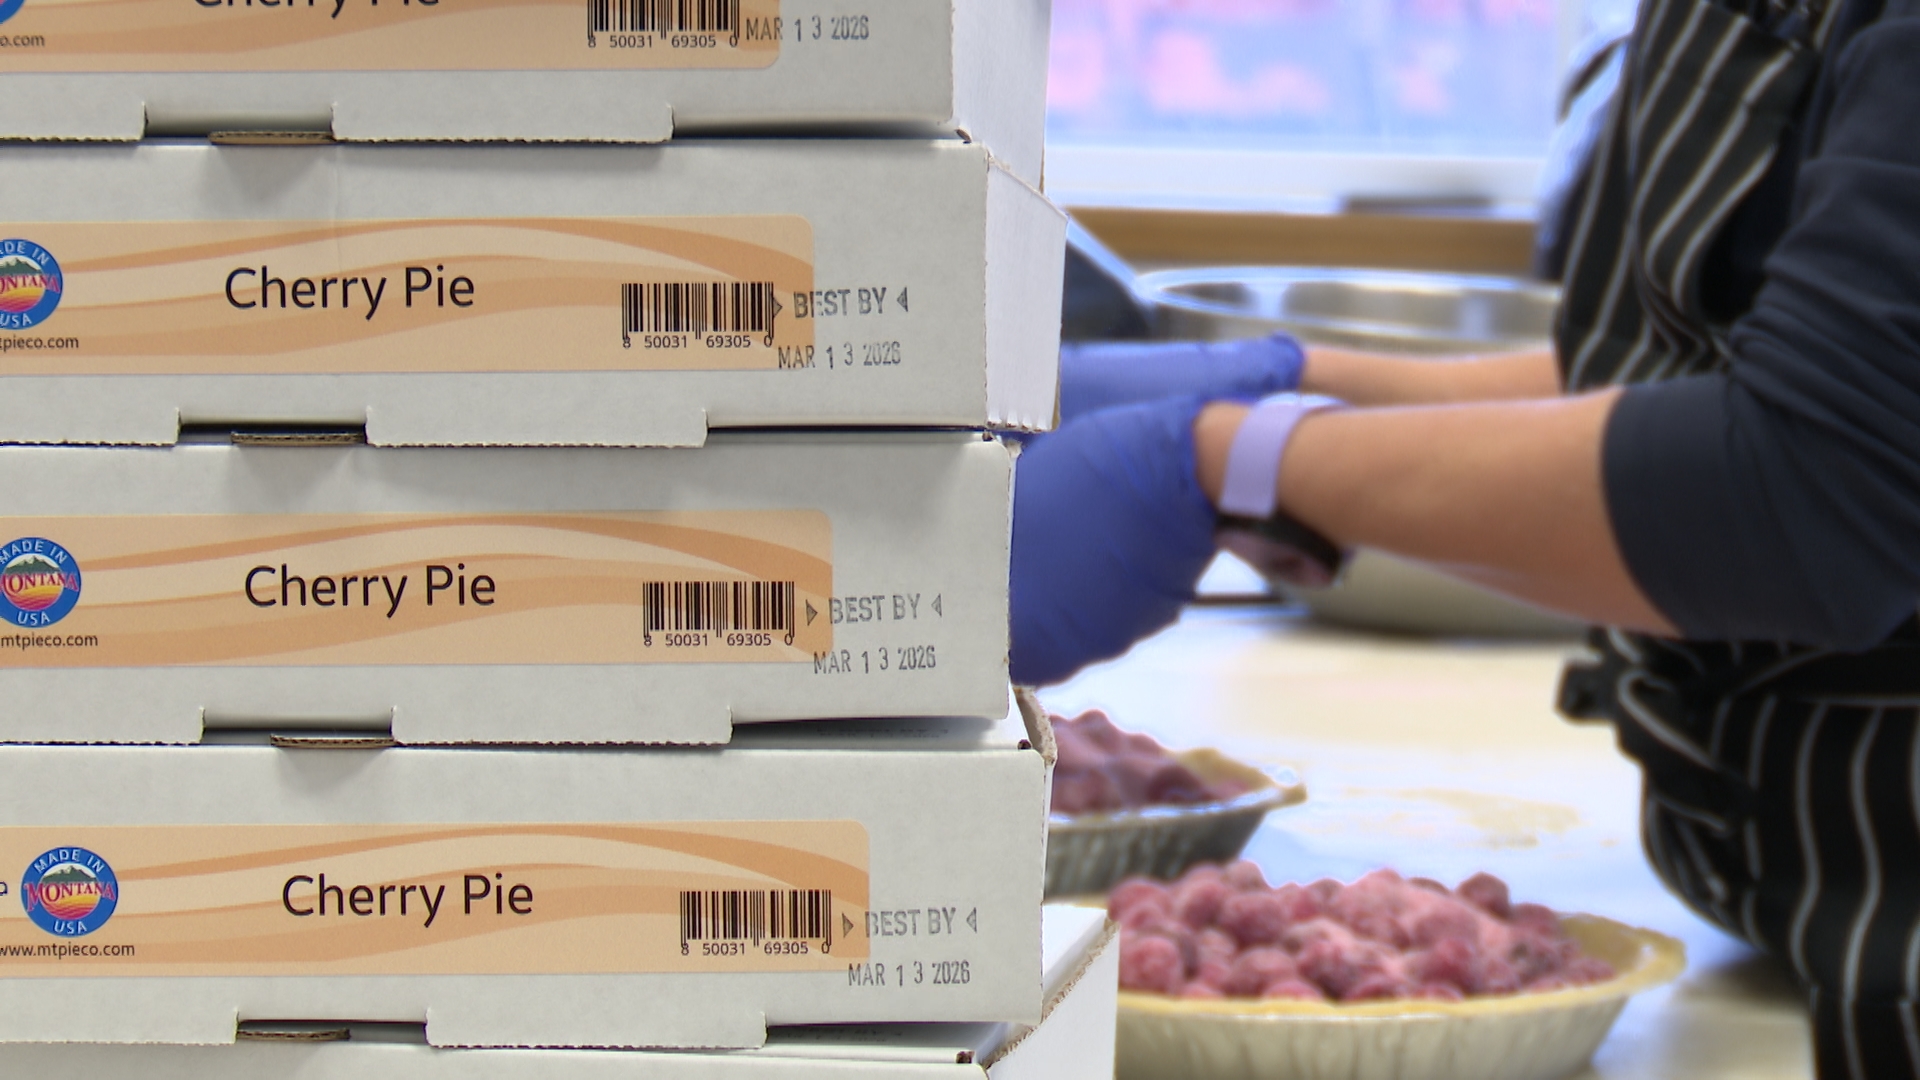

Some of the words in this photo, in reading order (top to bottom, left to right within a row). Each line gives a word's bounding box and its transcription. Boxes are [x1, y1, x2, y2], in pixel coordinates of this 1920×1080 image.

[609, 35, 654, 48] 50031
[671, 35, 717, 48] 69305
[745, 17, 784, 41] MAR
[794, 18, 803, 42] 1
[811, 15, 822, 40] 3
[830, 15, 870, 41] 2026
[225, 264, 388, 321] Cherry
[404, 263, 475, 308] Pie
[792, 289, 850, 319] BEST
[858, 286, 887, 316] BY
[644, 335, 687, 348] 50031
[706, 335, 751, 348] 69305
[777, 344, 816, 370] MAR
[825, 345, 834, 370] 1
[843, 342, 854, 367] 3
[862, 340, 902, 367] 2026
[0, 540, 44, 564] MADE
[50, 546, 68, 565] IN
[245, 563, 408, 619] Cherry
[426, 563, 496, 607] Pie
[17, 610, 51, 626] USA
[828, 594, 886, 624] BEST
[892, 593, 921, 620] BY
[665, 633, 708, 646] 50031
[726, 633, 772, 646] 69305
[814, 650, 851, 674] MAR
[861, 651, 870, 674] 1
[879, 647, 890, 670] 3
[897, 645, 936, 670] 2026
[33, 849, 81, 873] MADE
[86, 855, 105, 873] IN
[23, 881, 117, 912] MONTANA
[282, 873, 446, 928] Cherry
[463, 872, 534, 915] Pie
[53, 920, 88, 935] USA
[865, 909, 921, 937] BEST
[928, 907, 956, 934] BY
[702, 943, 746, 956] 50031
[764, 942, 809, 956] 69305
[848, 963, 886, 986] MAR
[896, 964, 904, 986] 1
[914, 960, 924, 984] 3
[933, 961, 971, 984] 2026
